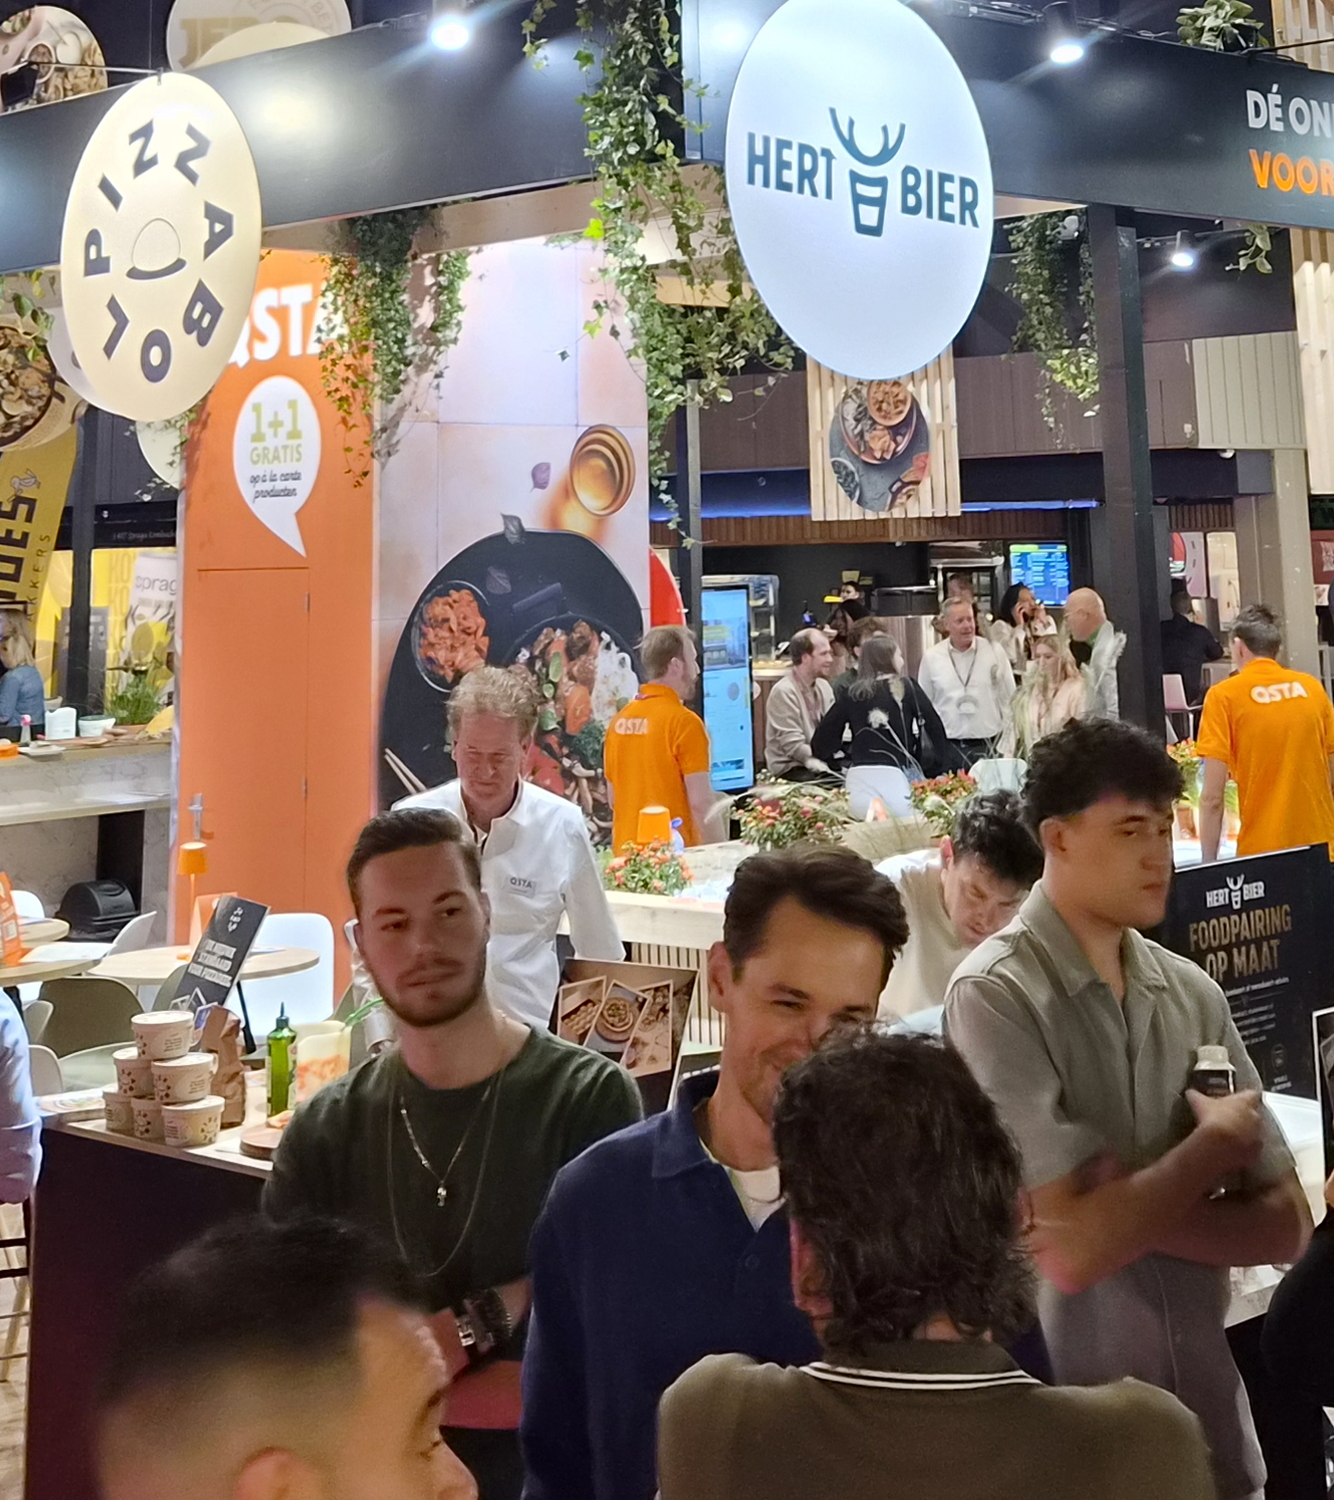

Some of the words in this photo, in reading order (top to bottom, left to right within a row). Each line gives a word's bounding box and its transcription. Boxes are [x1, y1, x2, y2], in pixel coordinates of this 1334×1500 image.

[1246, 84, 1285, 132] DÉ
[746, 131, 837, 201] HERT
[901, 165, 980, 229] BIER
[250, 444, 303, 466] GRATIS
[1250, 681, 1309, 704] QSTA
[510, 877, 533, 889] QSTA
[1206, 888, 1230, 908] HERT
[1243, 881, 1266, 901] BIER
[1189, 904, 1293, 952] FOODPAIRING
[1205, 953, 1229, 982] OP
[1232, 939, 1281, 978] MAAT
